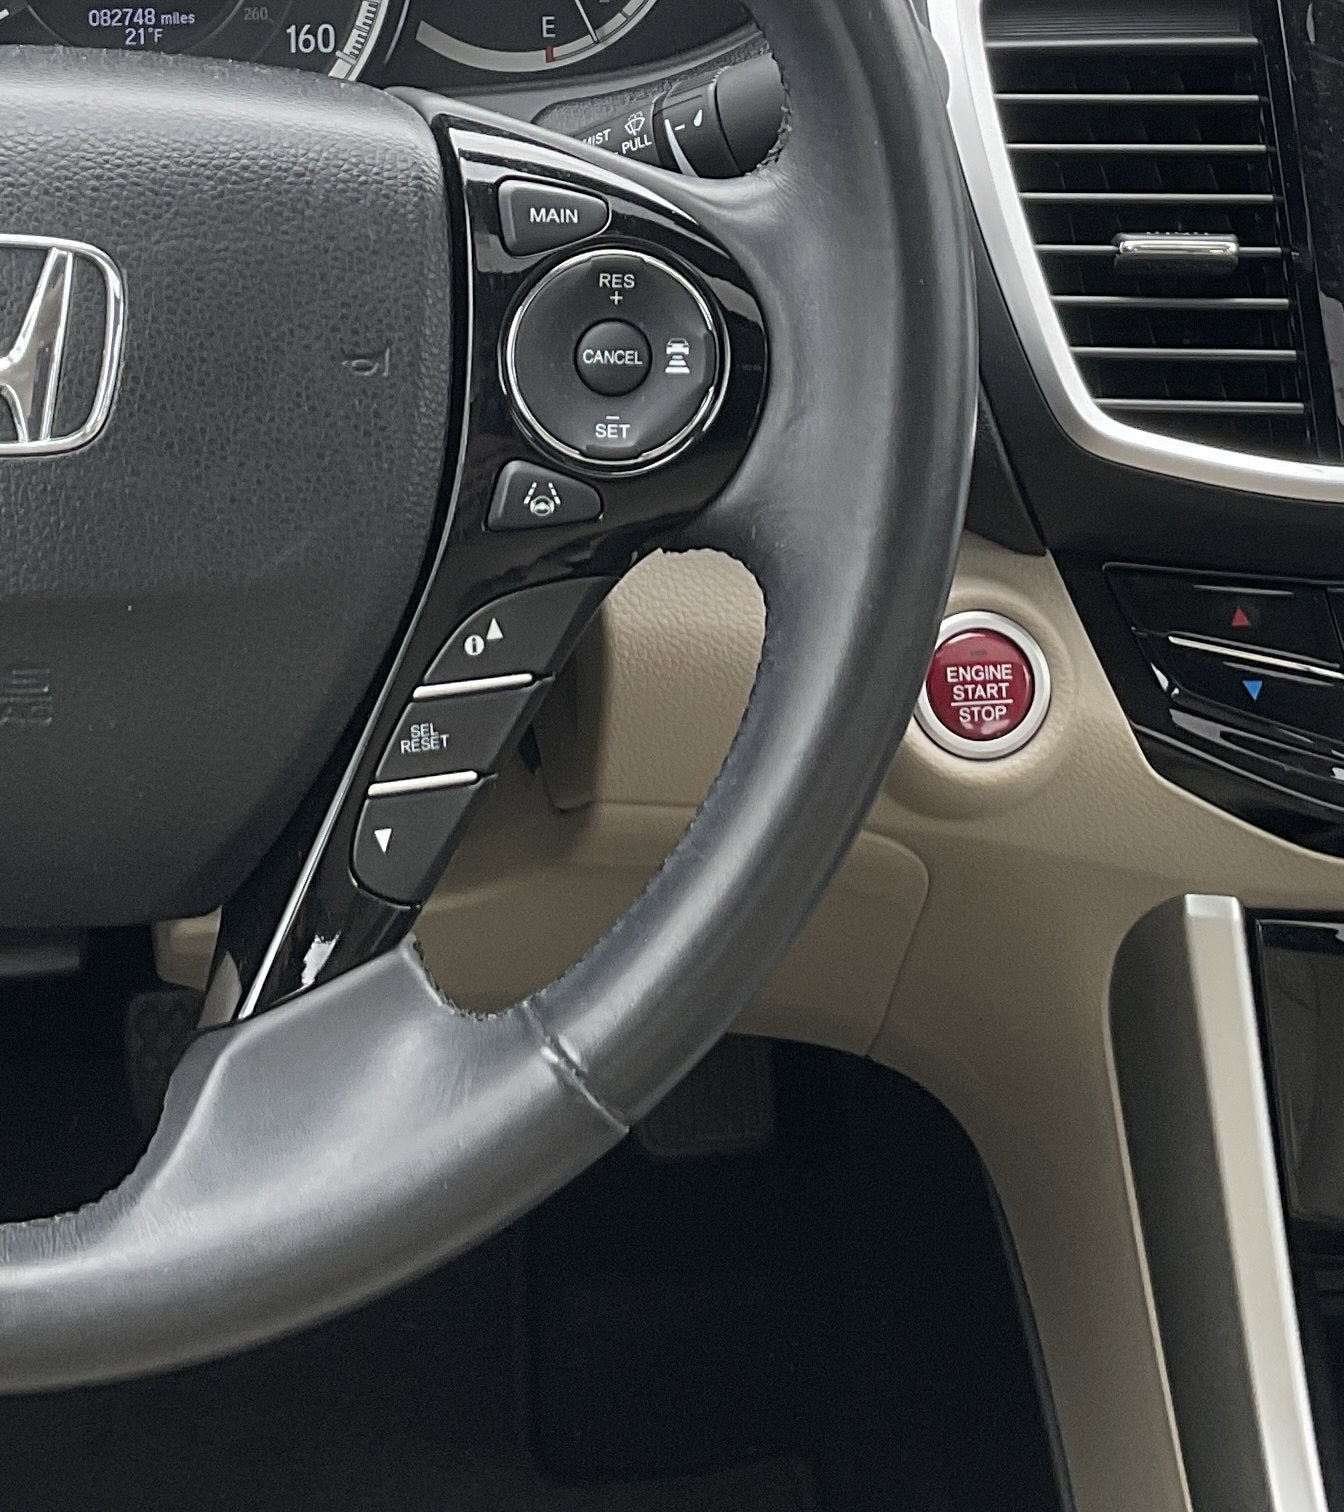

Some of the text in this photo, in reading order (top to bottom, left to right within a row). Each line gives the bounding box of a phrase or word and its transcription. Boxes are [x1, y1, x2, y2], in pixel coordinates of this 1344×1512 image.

[88, 7, 196, 27] 082748 miles
[243, 6, 269, 21] 260
[541, 15, 557, 38] E
[124, 27, 164, 46] 21°F
[286, 23, 335, 53] 160
[621, 134, 653, 155] PULL
[529, 207, 579, 225] MAIN
[598, 273, 636, 289] RES
[582, 348, 644, 366] CANCEL
[594, 423, 631, 439] SET
[945, 663, 1013, 683] ENGINE
[952, 682, 1010, 701] START
[958, 705, 1007, 723] STOP
[410, 722, 440, 739] SEL
[400, 734, 450, 755] RESET
